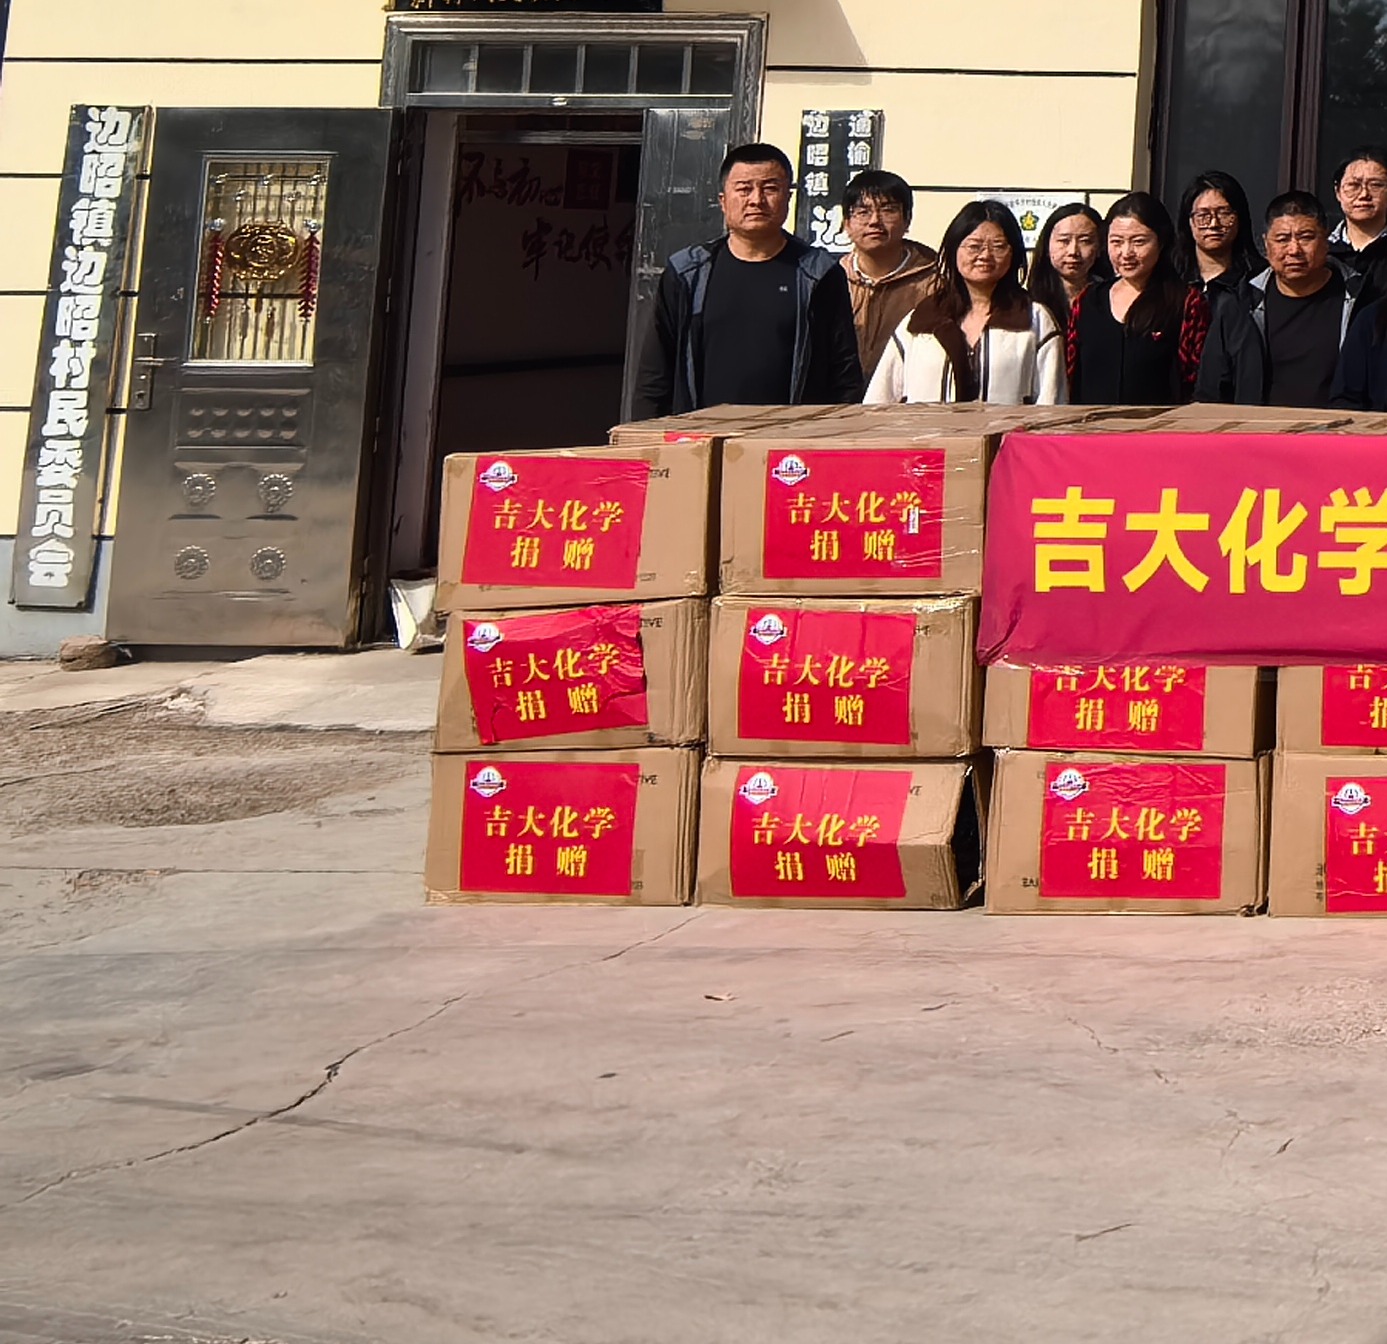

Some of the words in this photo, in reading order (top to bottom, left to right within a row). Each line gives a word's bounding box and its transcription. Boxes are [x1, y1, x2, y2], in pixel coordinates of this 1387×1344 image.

[803, 110, 830, 196] 边昭镇
[846, 109, 872, 186] 通榆
[28, 106, 132, 588] 边昭镇边昭村民委员会
[490, 501, 624, 532] 吉大化学
[786, 491, 922, 524] 吉大化学
[511, 537, 595, 570] 捐赠
[810, 531, 896, 561] 捐赠
[485, 643, 620, 688] 吉大化学
[760, 655, 891, 689] 吉大化学
[516, 682, 599, 721] 捐赠
[783, 694, 865, 725] 捐赠
[1075, 699, 1160, 731] 捐赠
[482, 806, 616, 839] 吉大化学
[749, 814, 880, 847] 吉大化学
[1063, 808, 1202, 842] 吉大化学
[505, 845, 588, 877] 捐赠
[775, 853, 856, 881] 捐赠
[1088, 849, 1175, 880] 捐赠
